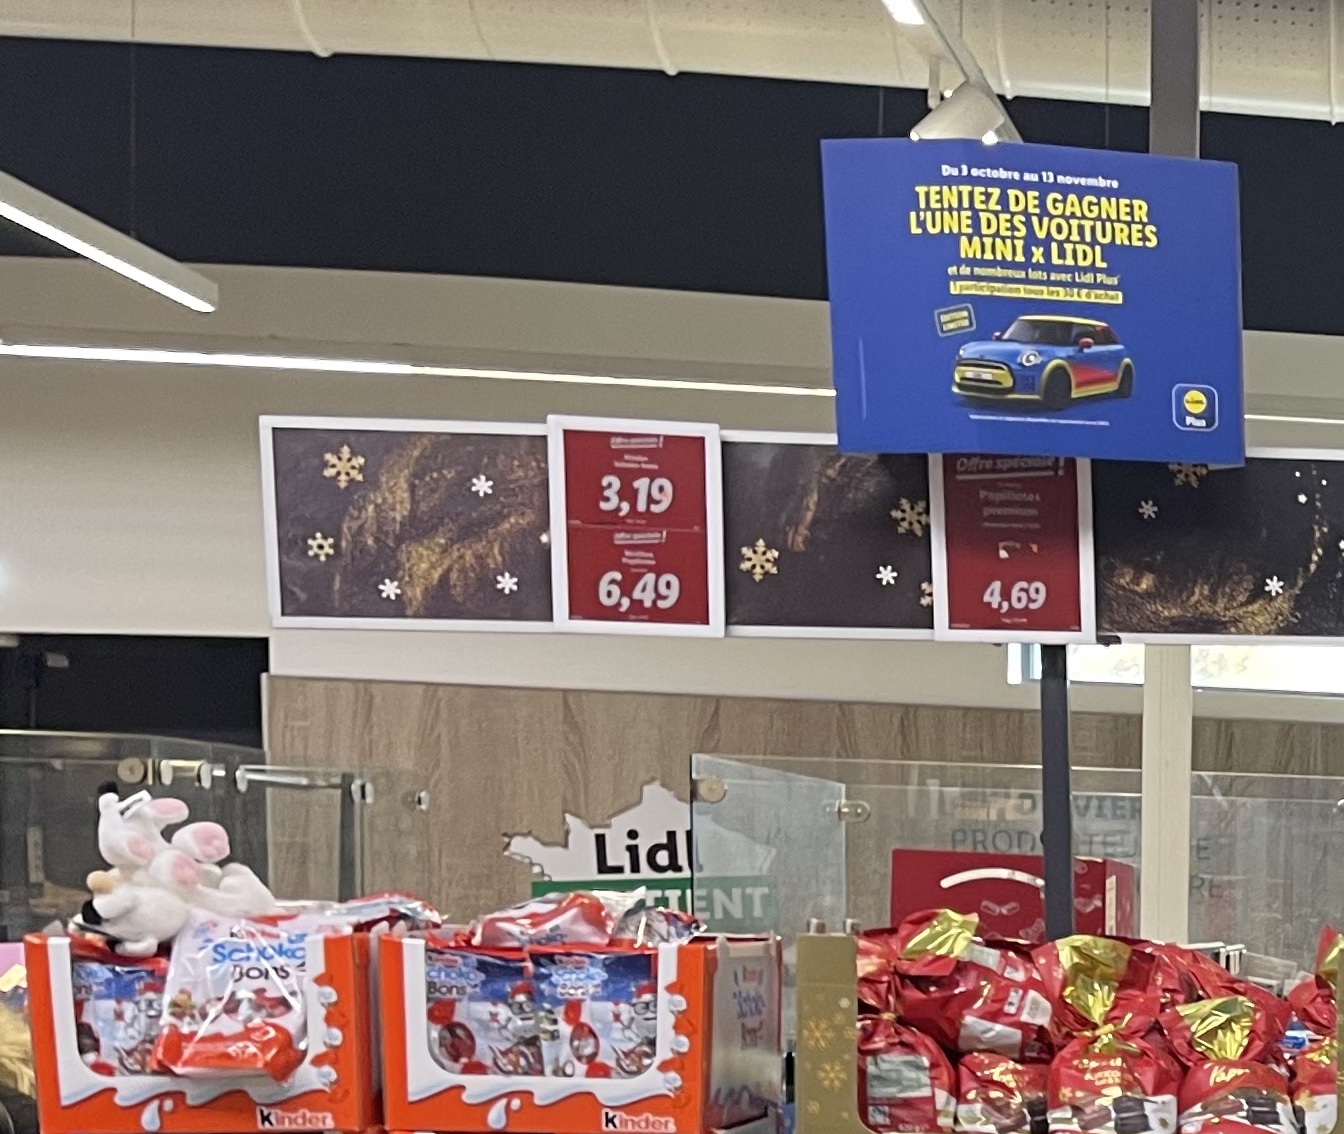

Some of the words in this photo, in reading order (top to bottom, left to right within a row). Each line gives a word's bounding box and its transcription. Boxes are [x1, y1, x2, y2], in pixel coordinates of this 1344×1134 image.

[941, 164, 959, 176] Du
[961, 164, 968, 176] 3
[970, 166, 1020, 181] octobre
[1023, 171, 1039, 182] au
[1041, 171, 1054, 183] 13
[1057, 174, 1119, 189] novembre
[915, 185, 1002, 211] TENTEZ
[1007, 189, 1040, 214] DE
[1046, 192, 1149, 222] GAGNER
[909, 210, 973, 235] L'UNE
[980, 212, 1027, 238] DES
[1031, 216, 1159, 248] VOITURES
[959, 235, 1025, 262] MINI
[1031, 246, 1045, 263] x
[1051, 241, 1107, 268] LIDL
[599, 474, 674, 517] 3,19
[598, 570, 680, 612] 6,49
[982, 579, 1047, 613] 4,69
[595, 829, 703, 875] Lidl
